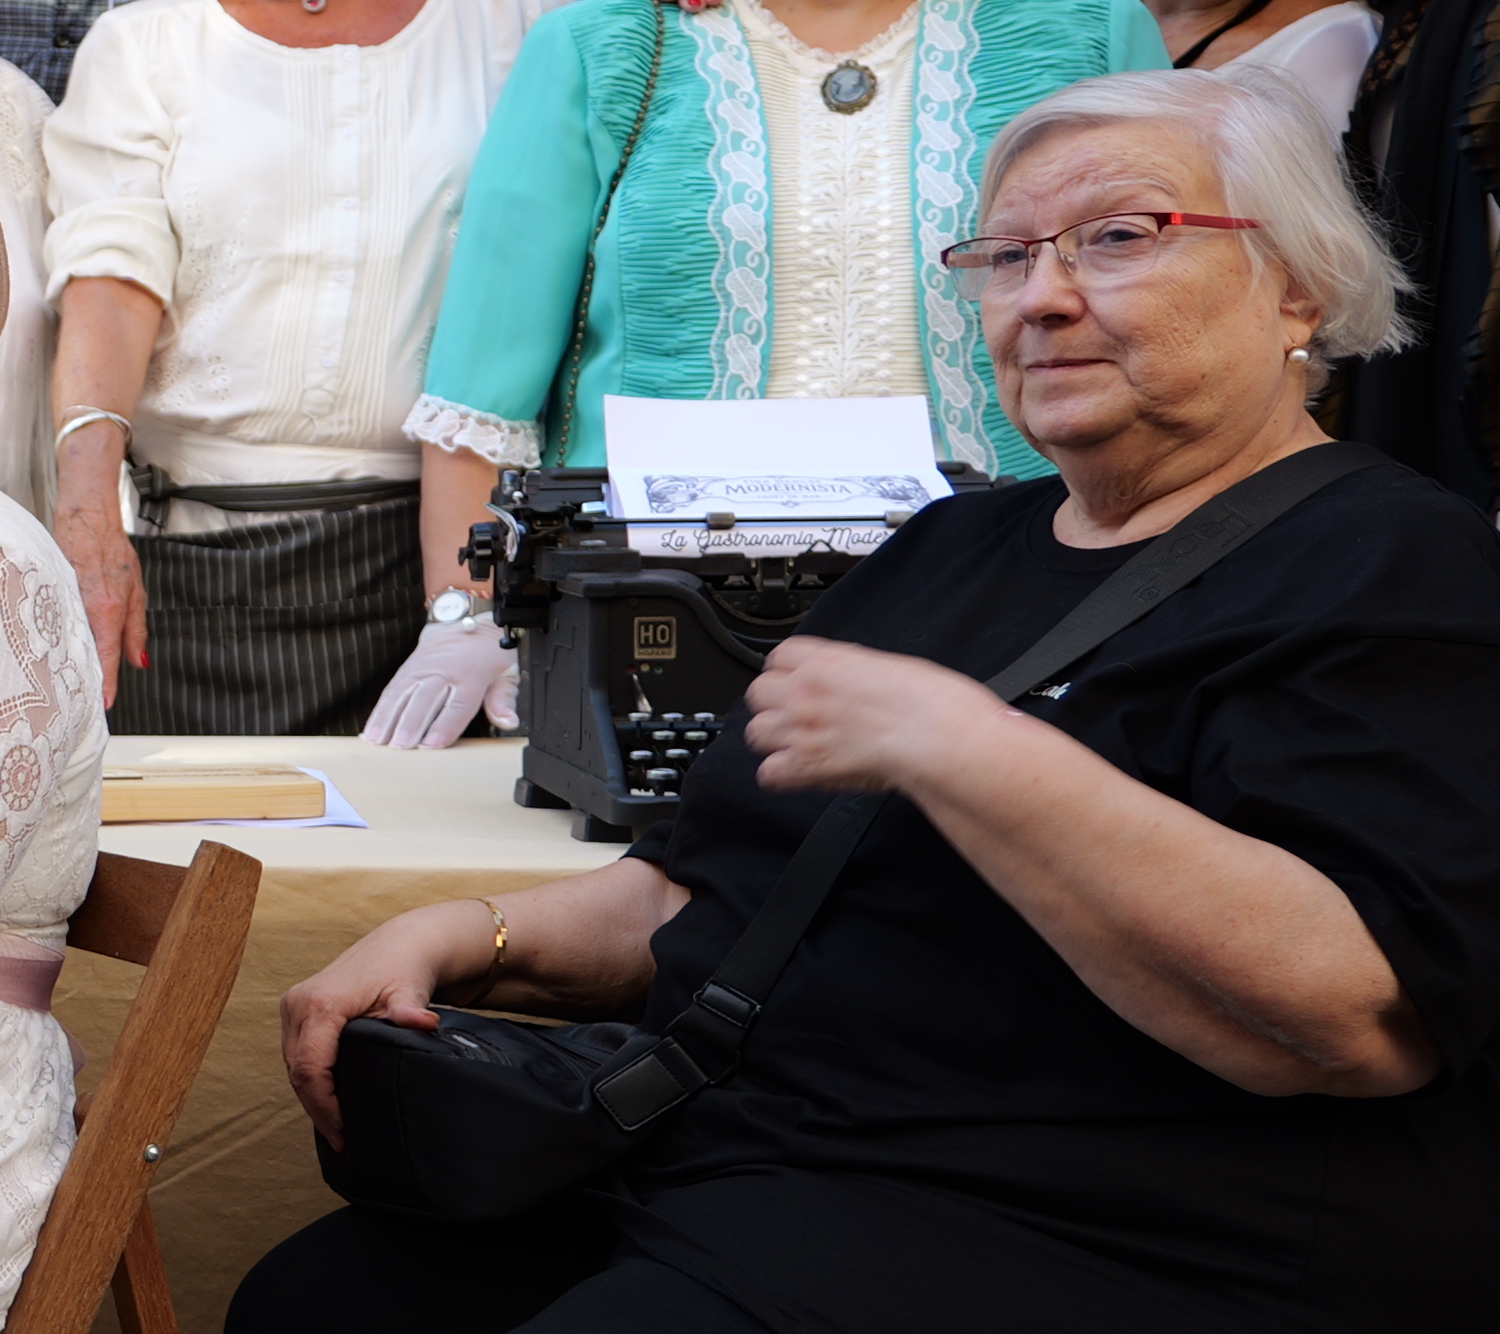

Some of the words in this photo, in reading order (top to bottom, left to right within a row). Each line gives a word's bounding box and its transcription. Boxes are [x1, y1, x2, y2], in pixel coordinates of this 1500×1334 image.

[724, 483, 852, 495] MODERNISTA
[661, 528, 688, 552] La
[694, 528, 815, 556] Gastronomia
[640, 624, 670, 644] HO
